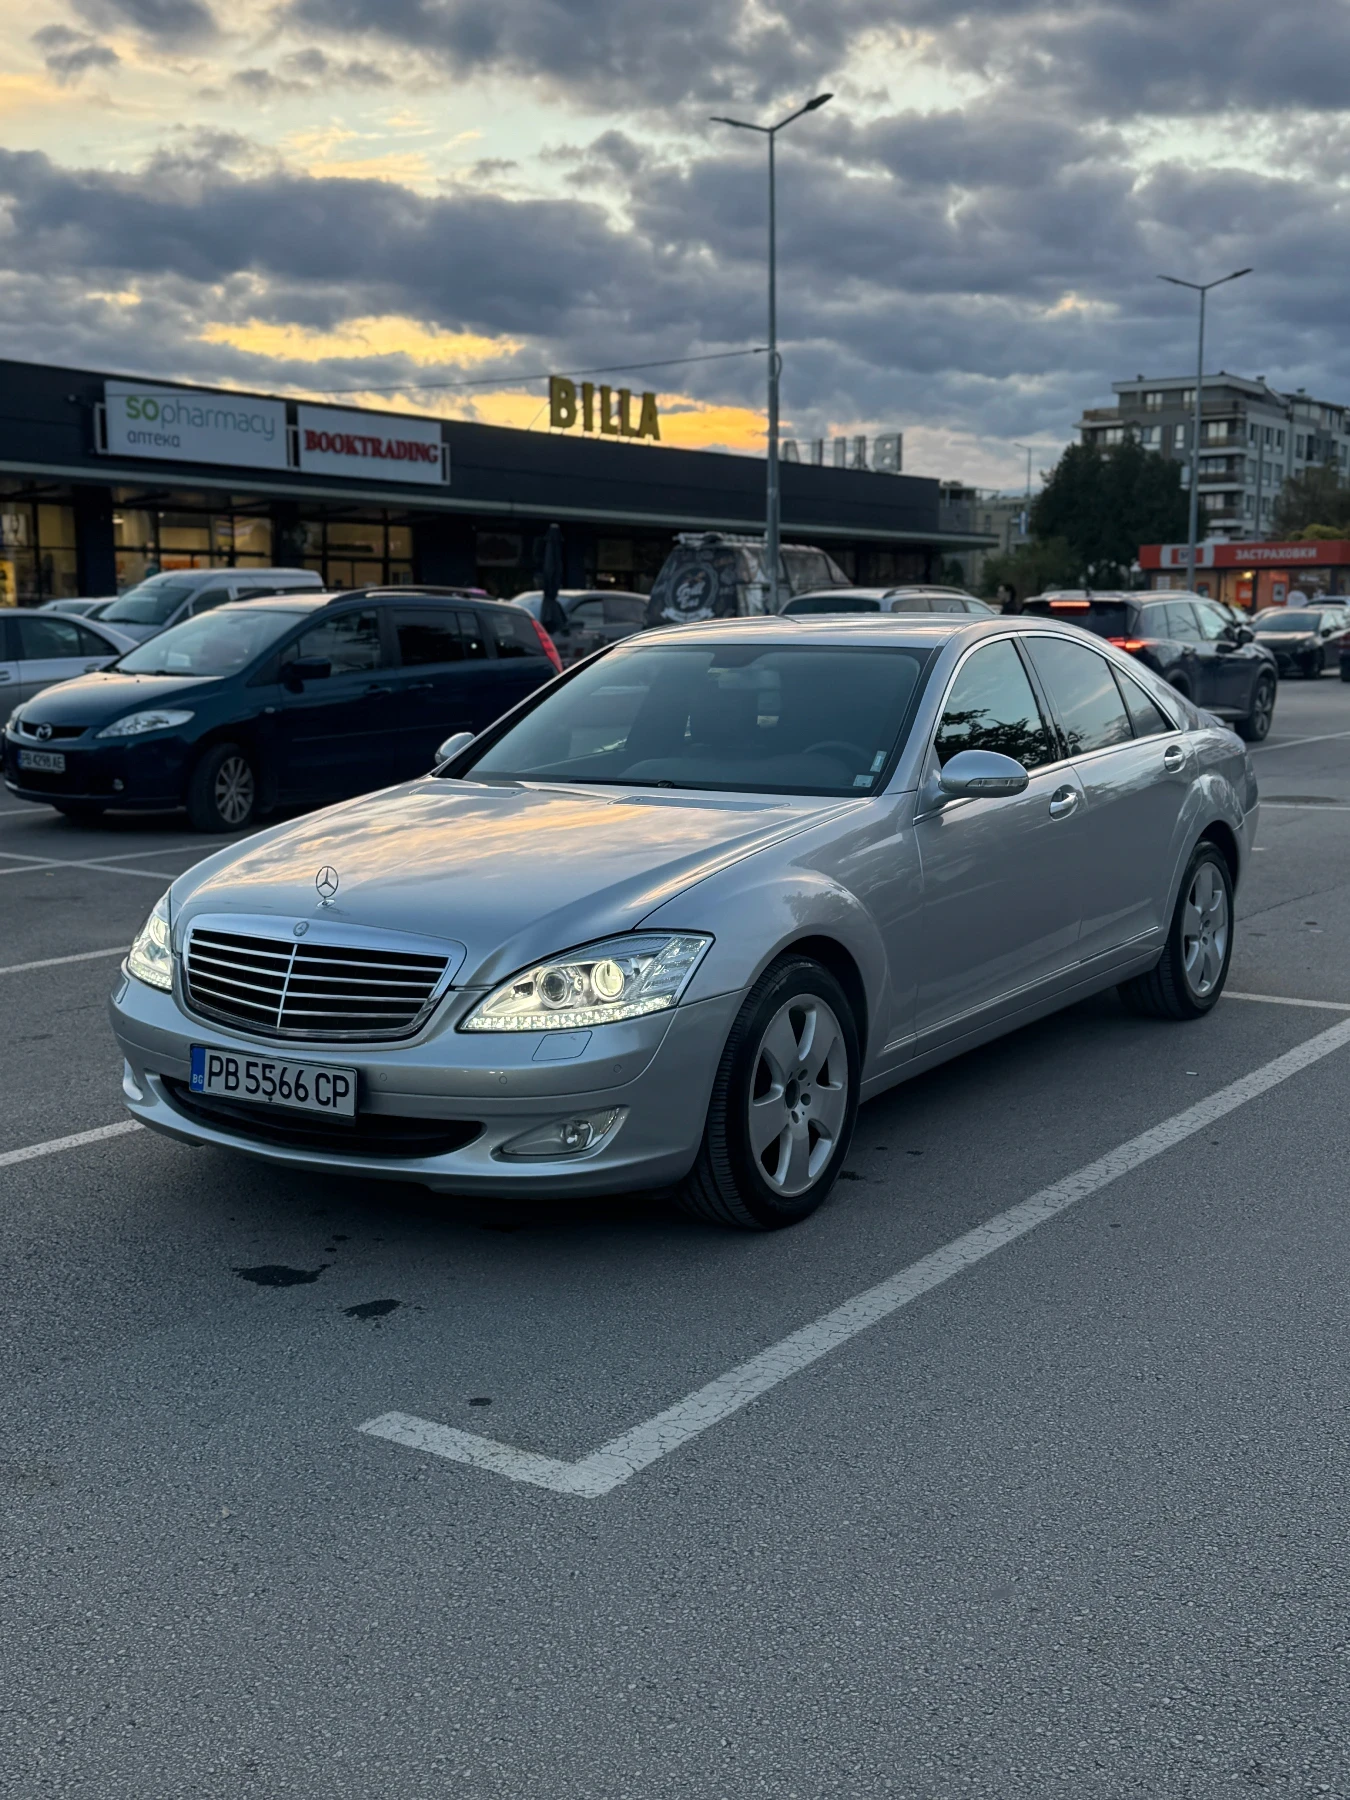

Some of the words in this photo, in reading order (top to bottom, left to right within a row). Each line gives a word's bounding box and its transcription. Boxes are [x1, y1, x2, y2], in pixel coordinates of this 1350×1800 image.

[549, 376, 661, 441] BILLA
[127, 430, 181, 448] аптека
[304, 429, 439, 463] BOOKTRADING
[1235, 547, 1317, 560] ЗАСТРАХОВКИ
[192, 1073, 204, 1085] BG
[207, 1055, 240, 1091] PB
[245, 1061, 309, 1102] 5566
[315, 1073, 350, 1108] CP
